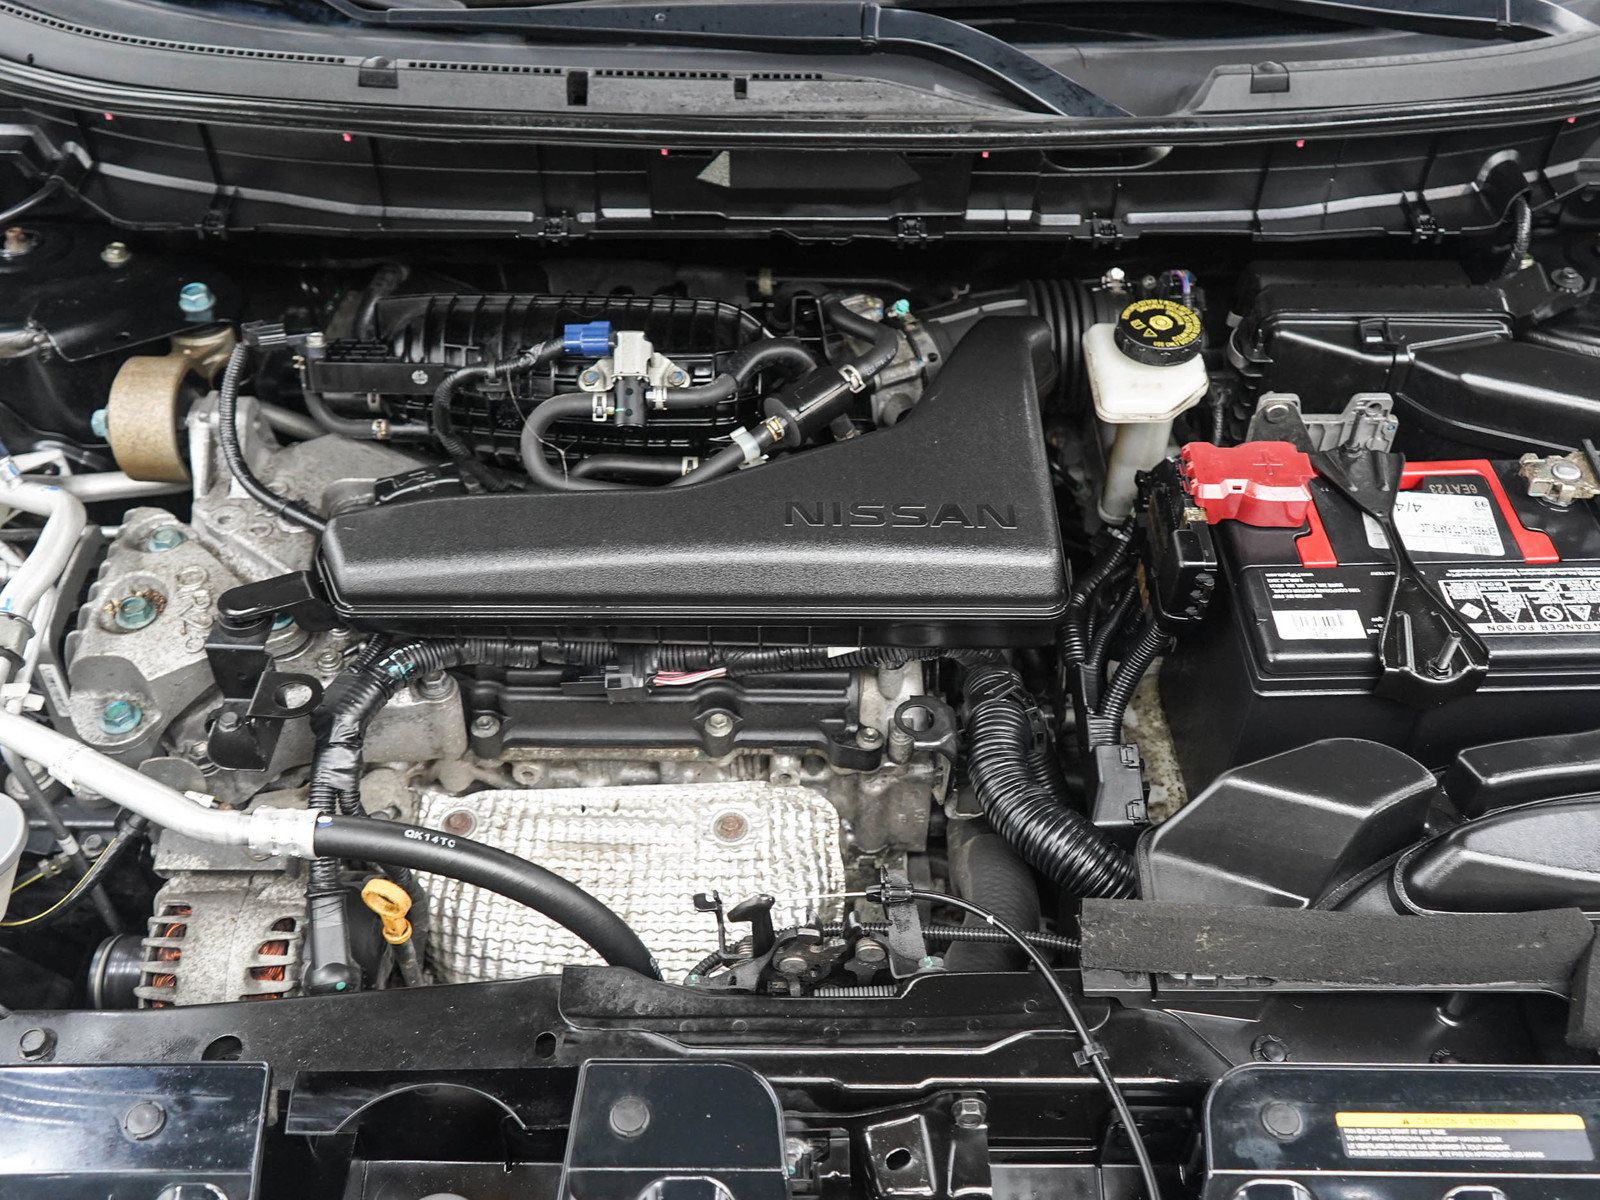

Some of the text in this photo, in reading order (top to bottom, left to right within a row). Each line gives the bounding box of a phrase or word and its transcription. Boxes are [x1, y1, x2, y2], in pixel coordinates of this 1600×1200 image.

[1428, 483, 1479, 495] 6EAT23
[784, 501, 1018, 530] NISSAN
[1540, 624, 1592, 632] DANGER
